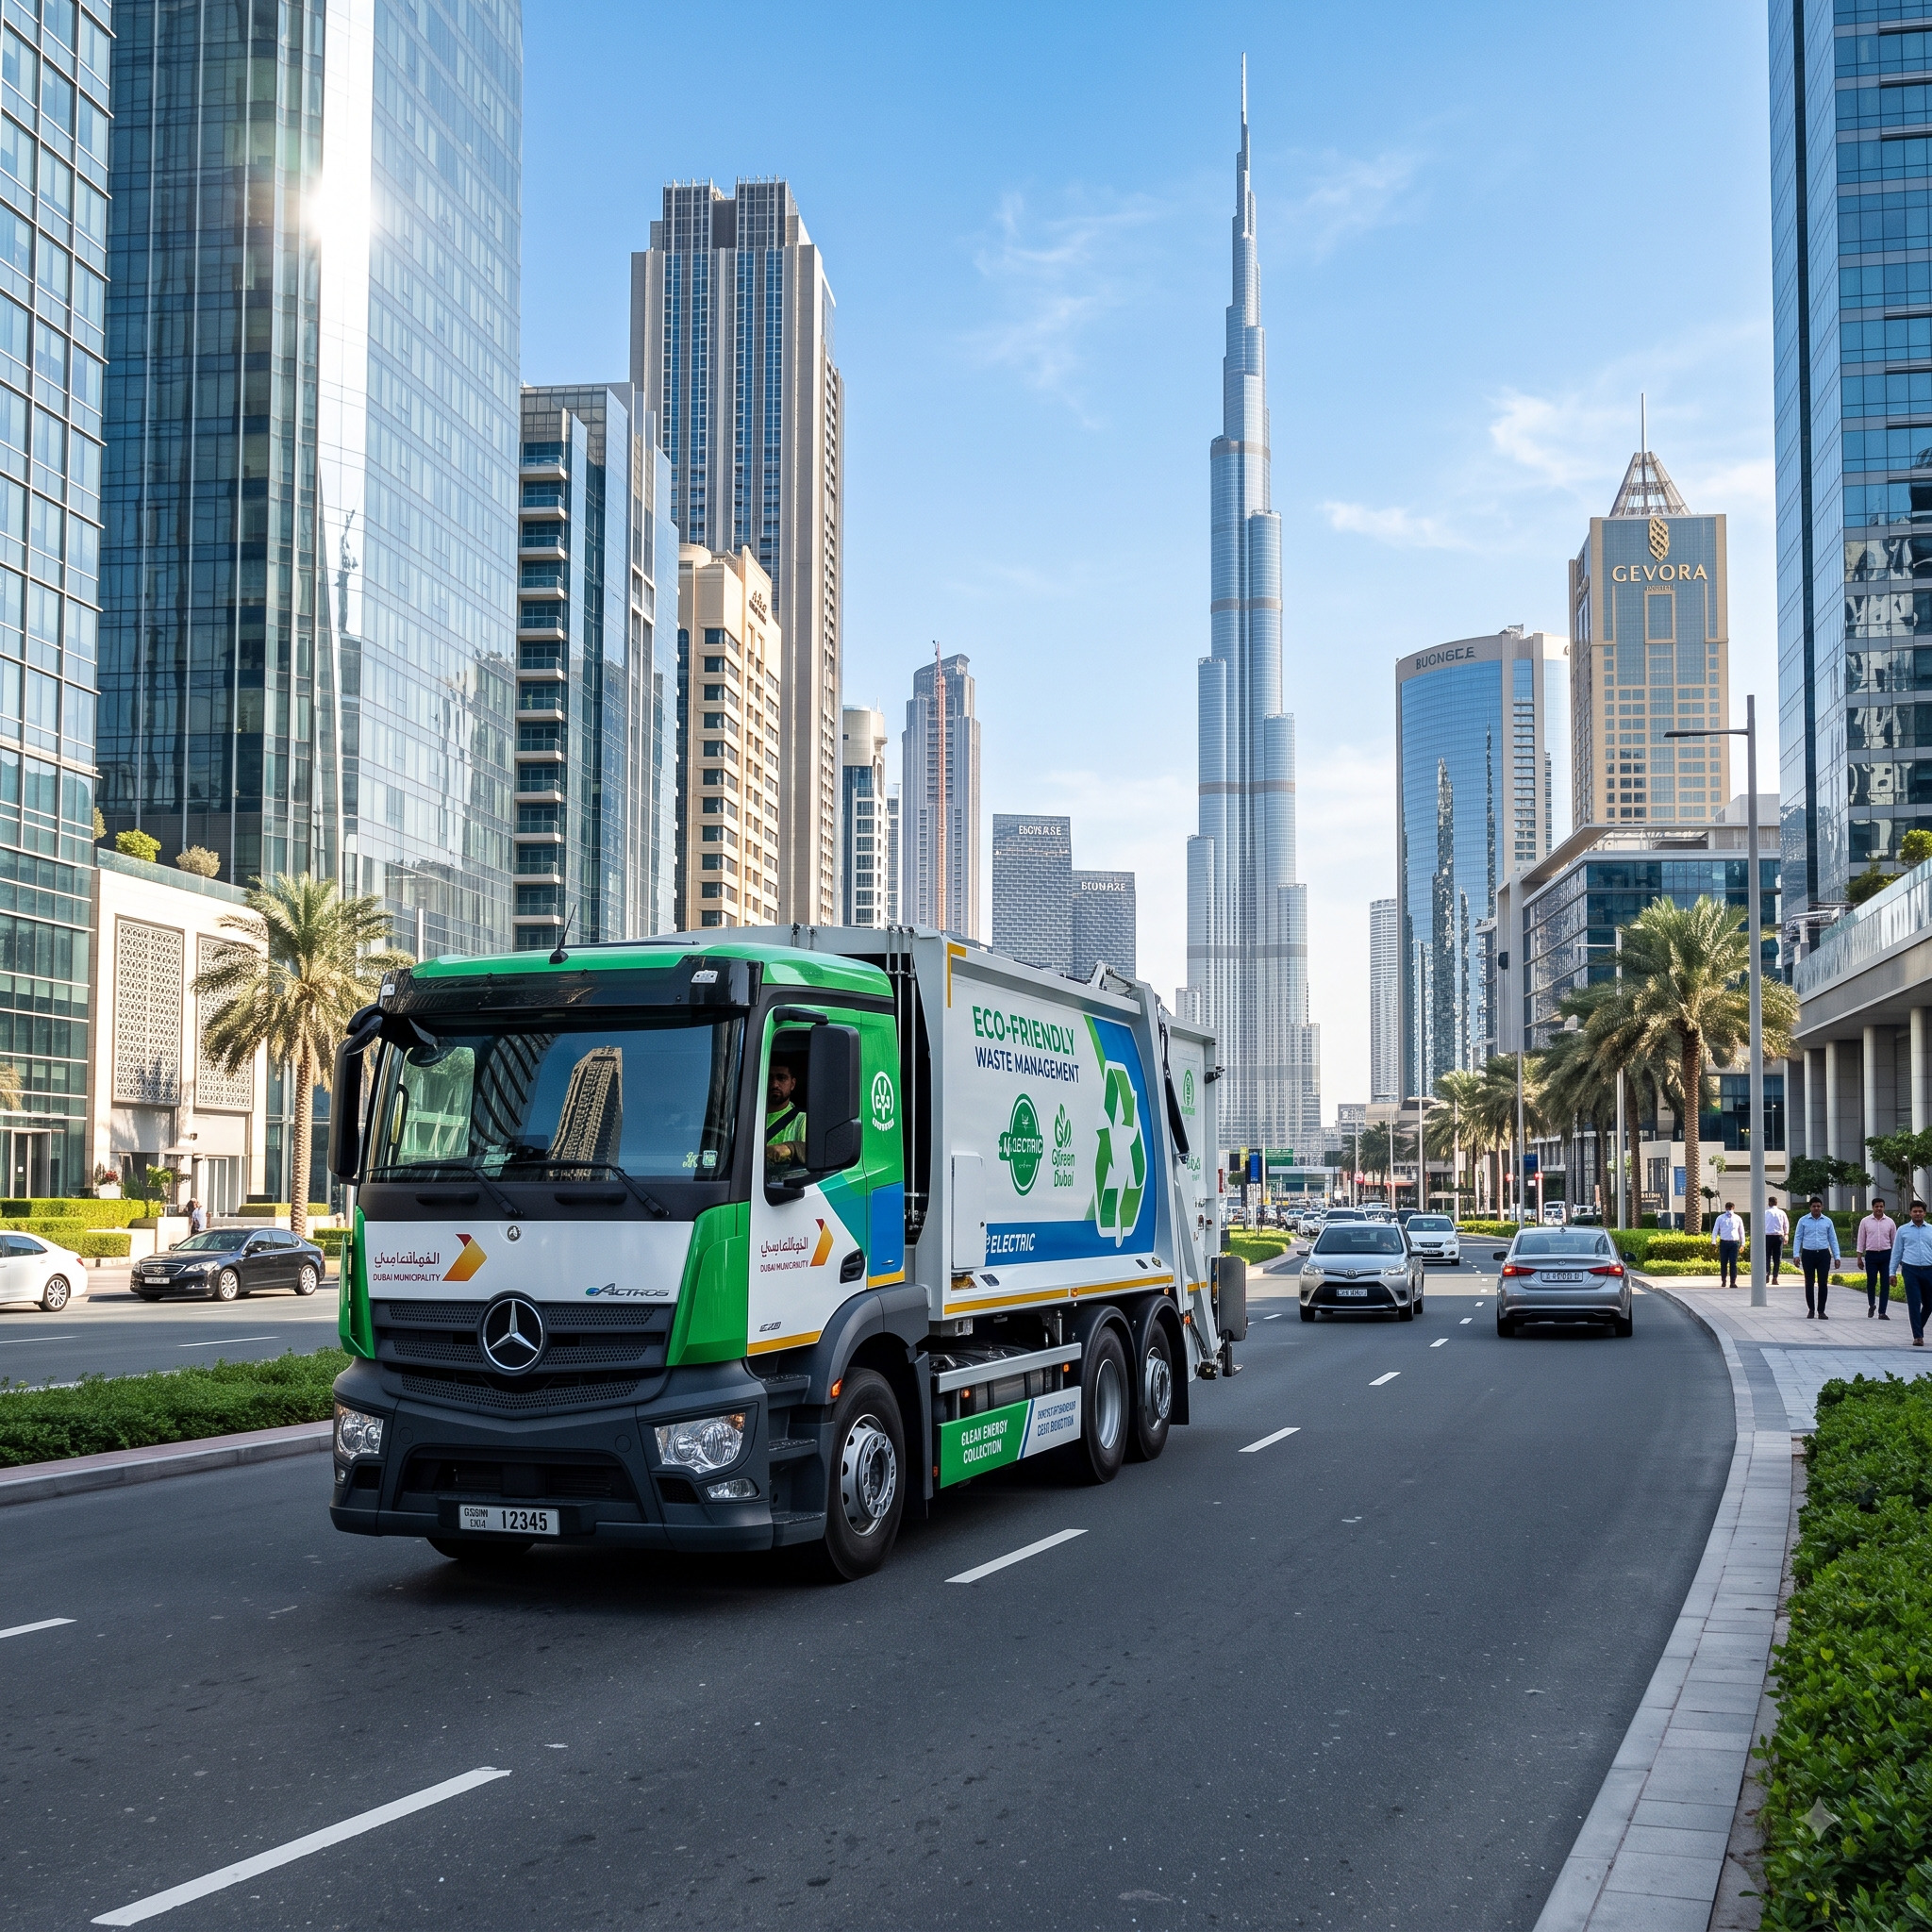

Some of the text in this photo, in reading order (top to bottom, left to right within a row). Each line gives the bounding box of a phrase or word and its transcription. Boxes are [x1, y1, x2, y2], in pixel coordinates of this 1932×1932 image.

[1611, 563, 1708, 583] GEVORA
[972, 1005, 1074, 1057] ECO-FRIENDLY
[974, 1045, 1079, 1084] WASTE MANAGEMENT
[373, 1273, 393, 1281] DUBAI
[501, 1509, 548, 1531] 12345
